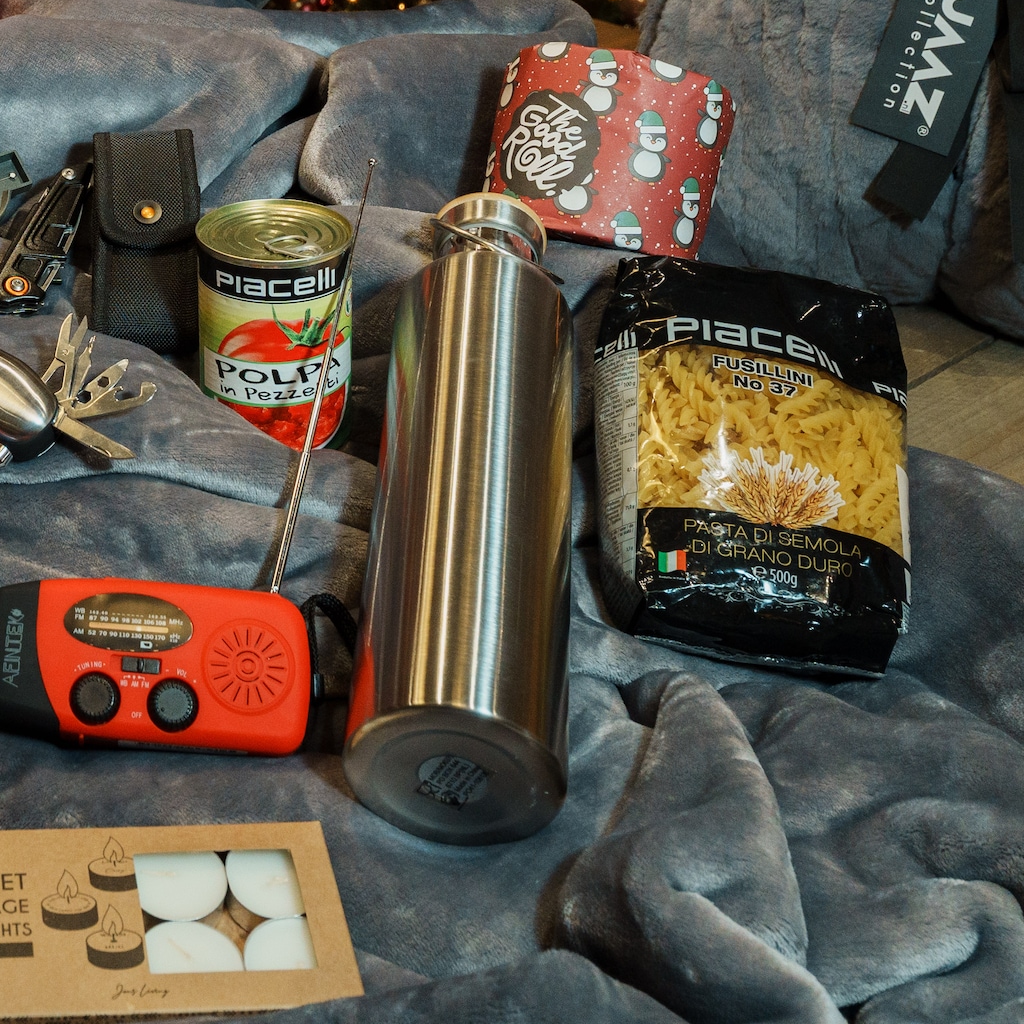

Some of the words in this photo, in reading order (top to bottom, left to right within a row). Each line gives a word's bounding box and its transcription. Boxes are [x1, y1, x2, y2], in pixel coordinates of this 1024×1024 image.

[545, 93, 588, 140] The
[520, 104, 587, 160] Good
[712, 354, 814, 388] FUSILLINI
[220, 379, 237, 396] in
[245, 372, 339, 401] Pezzeti
[733, 375, 763, 392] No
[769, 381, 798, 398] 37
[684, 518, 748, 540] PASTA
[753, 528, 773, 543] DI
[779, 531, 862, 559] SEMOLA
[692, 539, 711, 554] DI
[717, 544, 792, 567] GRANO
[798, 555, 853, 578] DURO
[770, 569, 798, 588] 500g
[77, 661, 103, 671] TUNING
[176, 668, 188, 678] VOL
[131, 711, 143, 719] OFF
